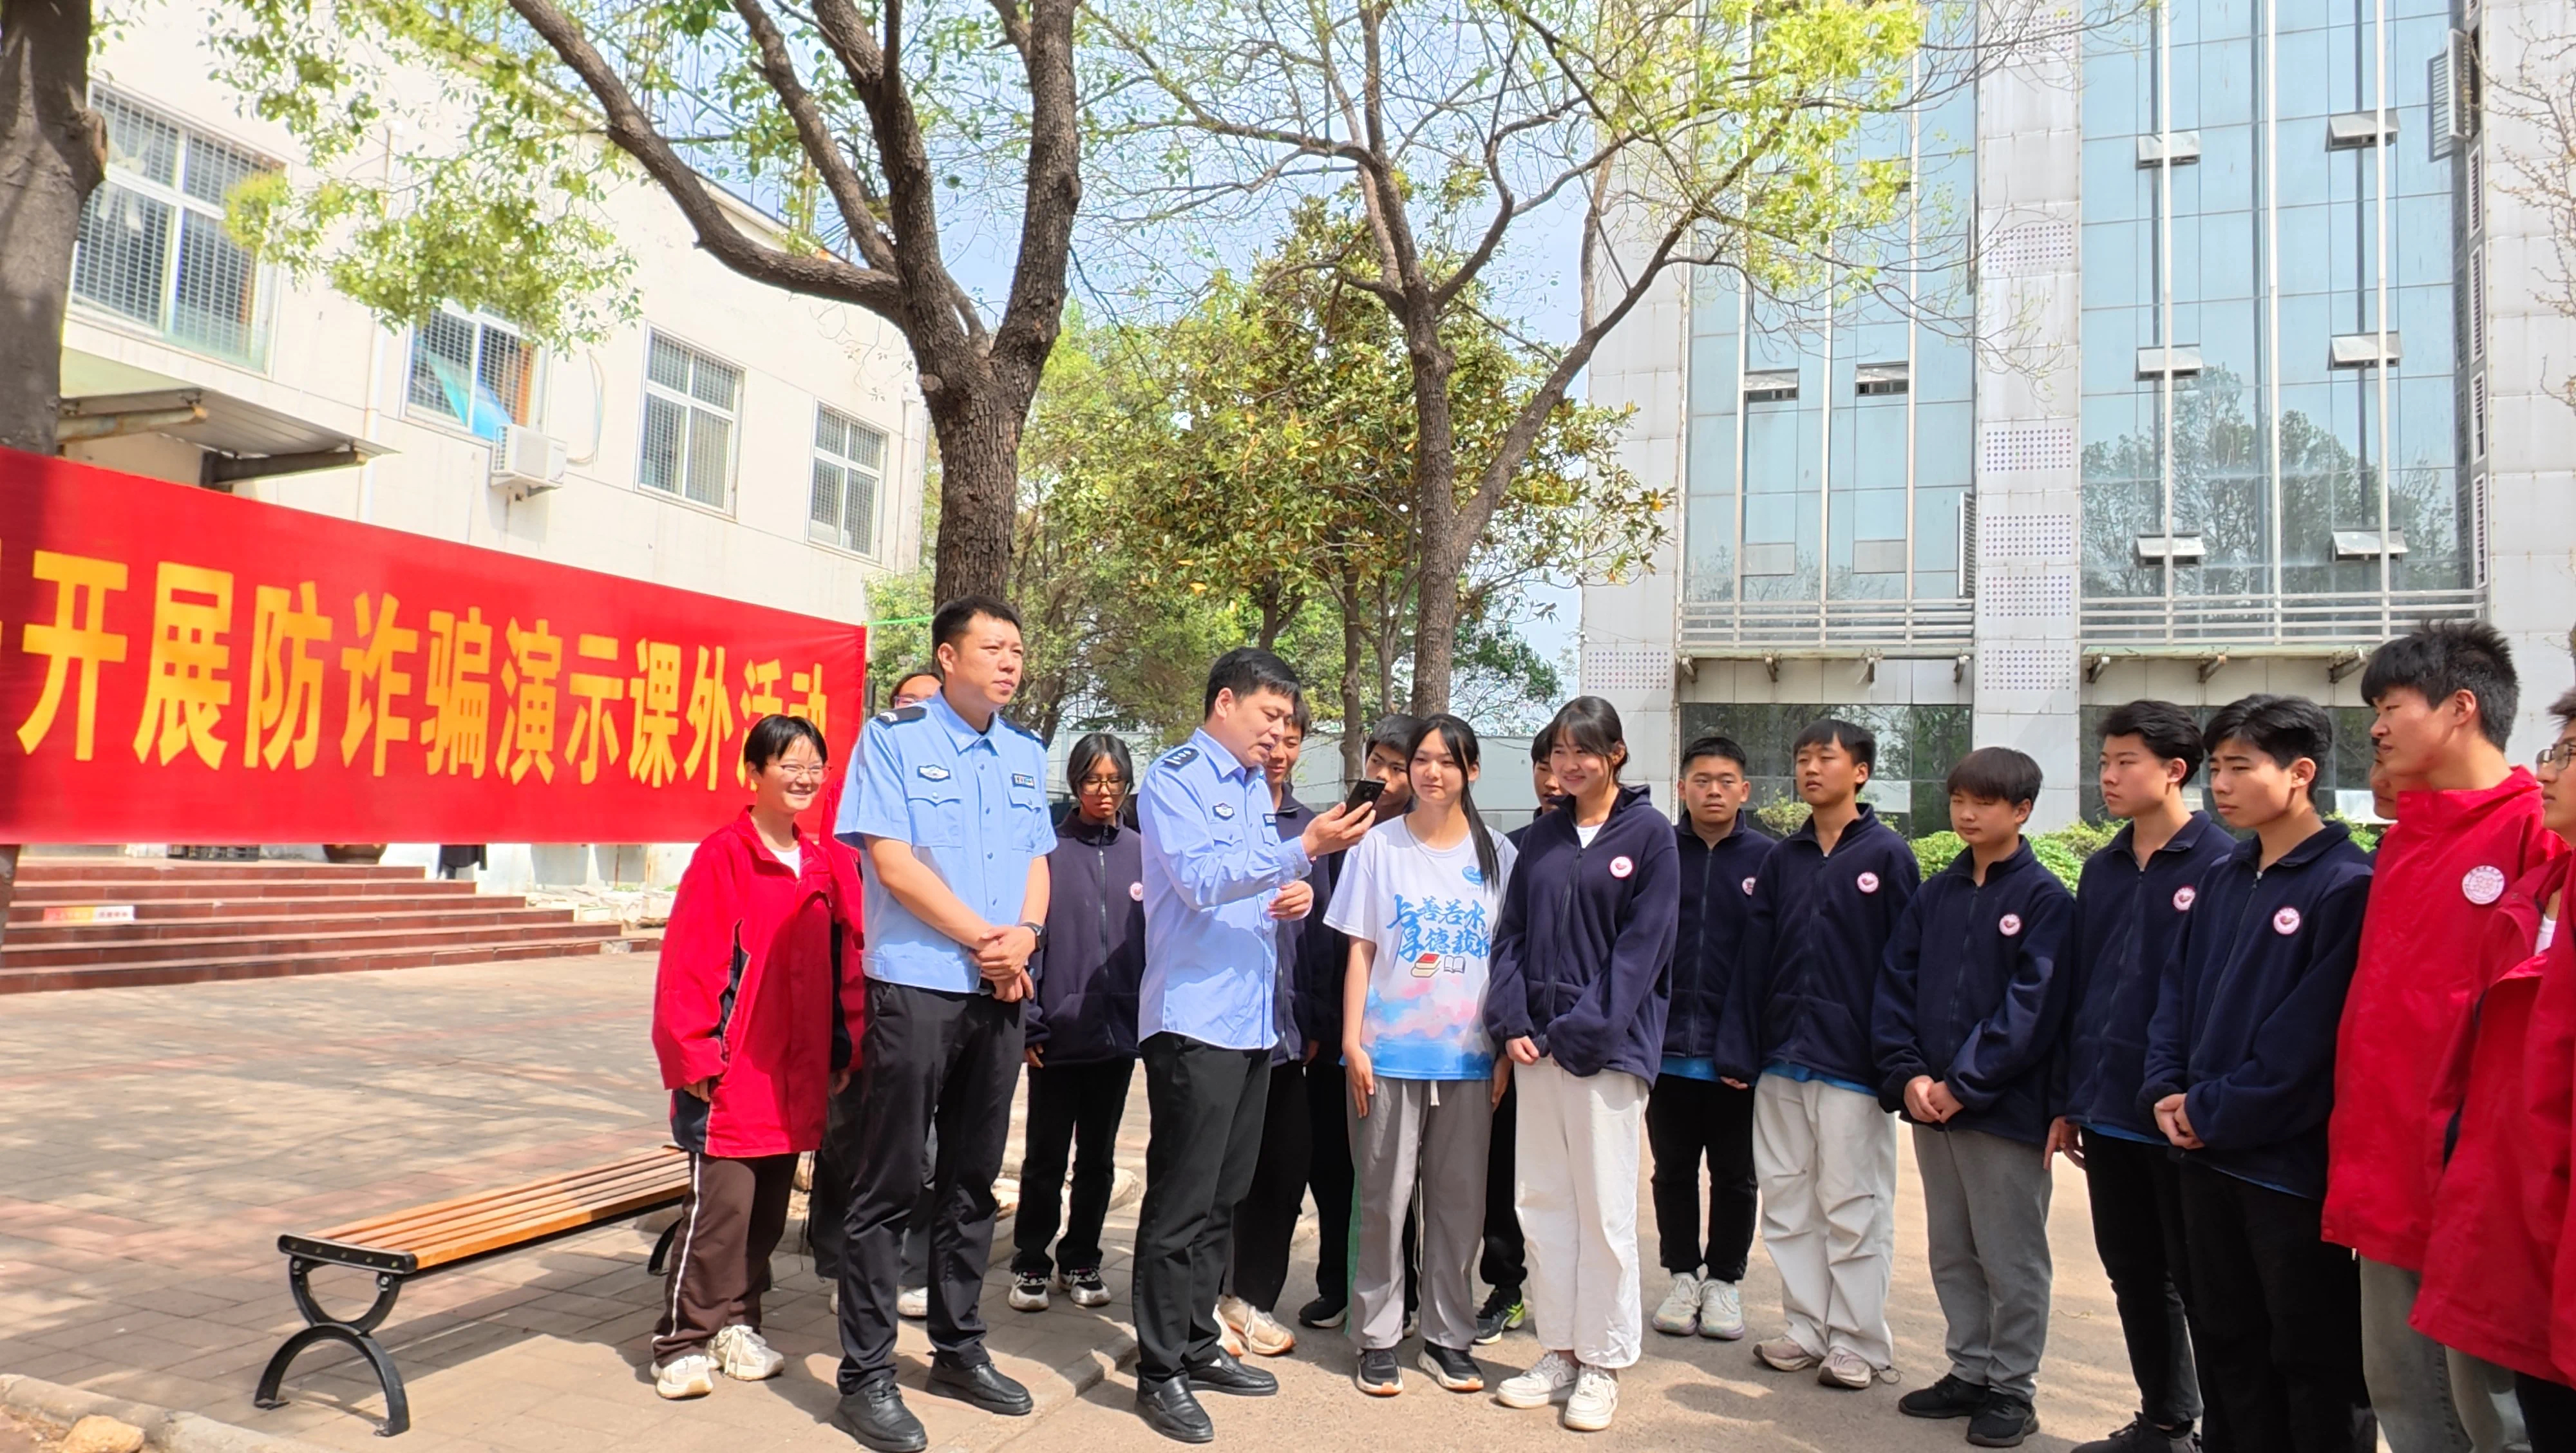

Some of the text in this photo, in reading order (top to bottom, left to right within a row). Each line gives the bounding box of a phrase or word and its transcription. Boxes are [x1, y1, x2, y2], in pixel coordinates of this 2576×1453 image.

[0, 540, 827, 791] 开展防诈骗演示课外活
[1386, 894, 1486, 931] 上善若水
